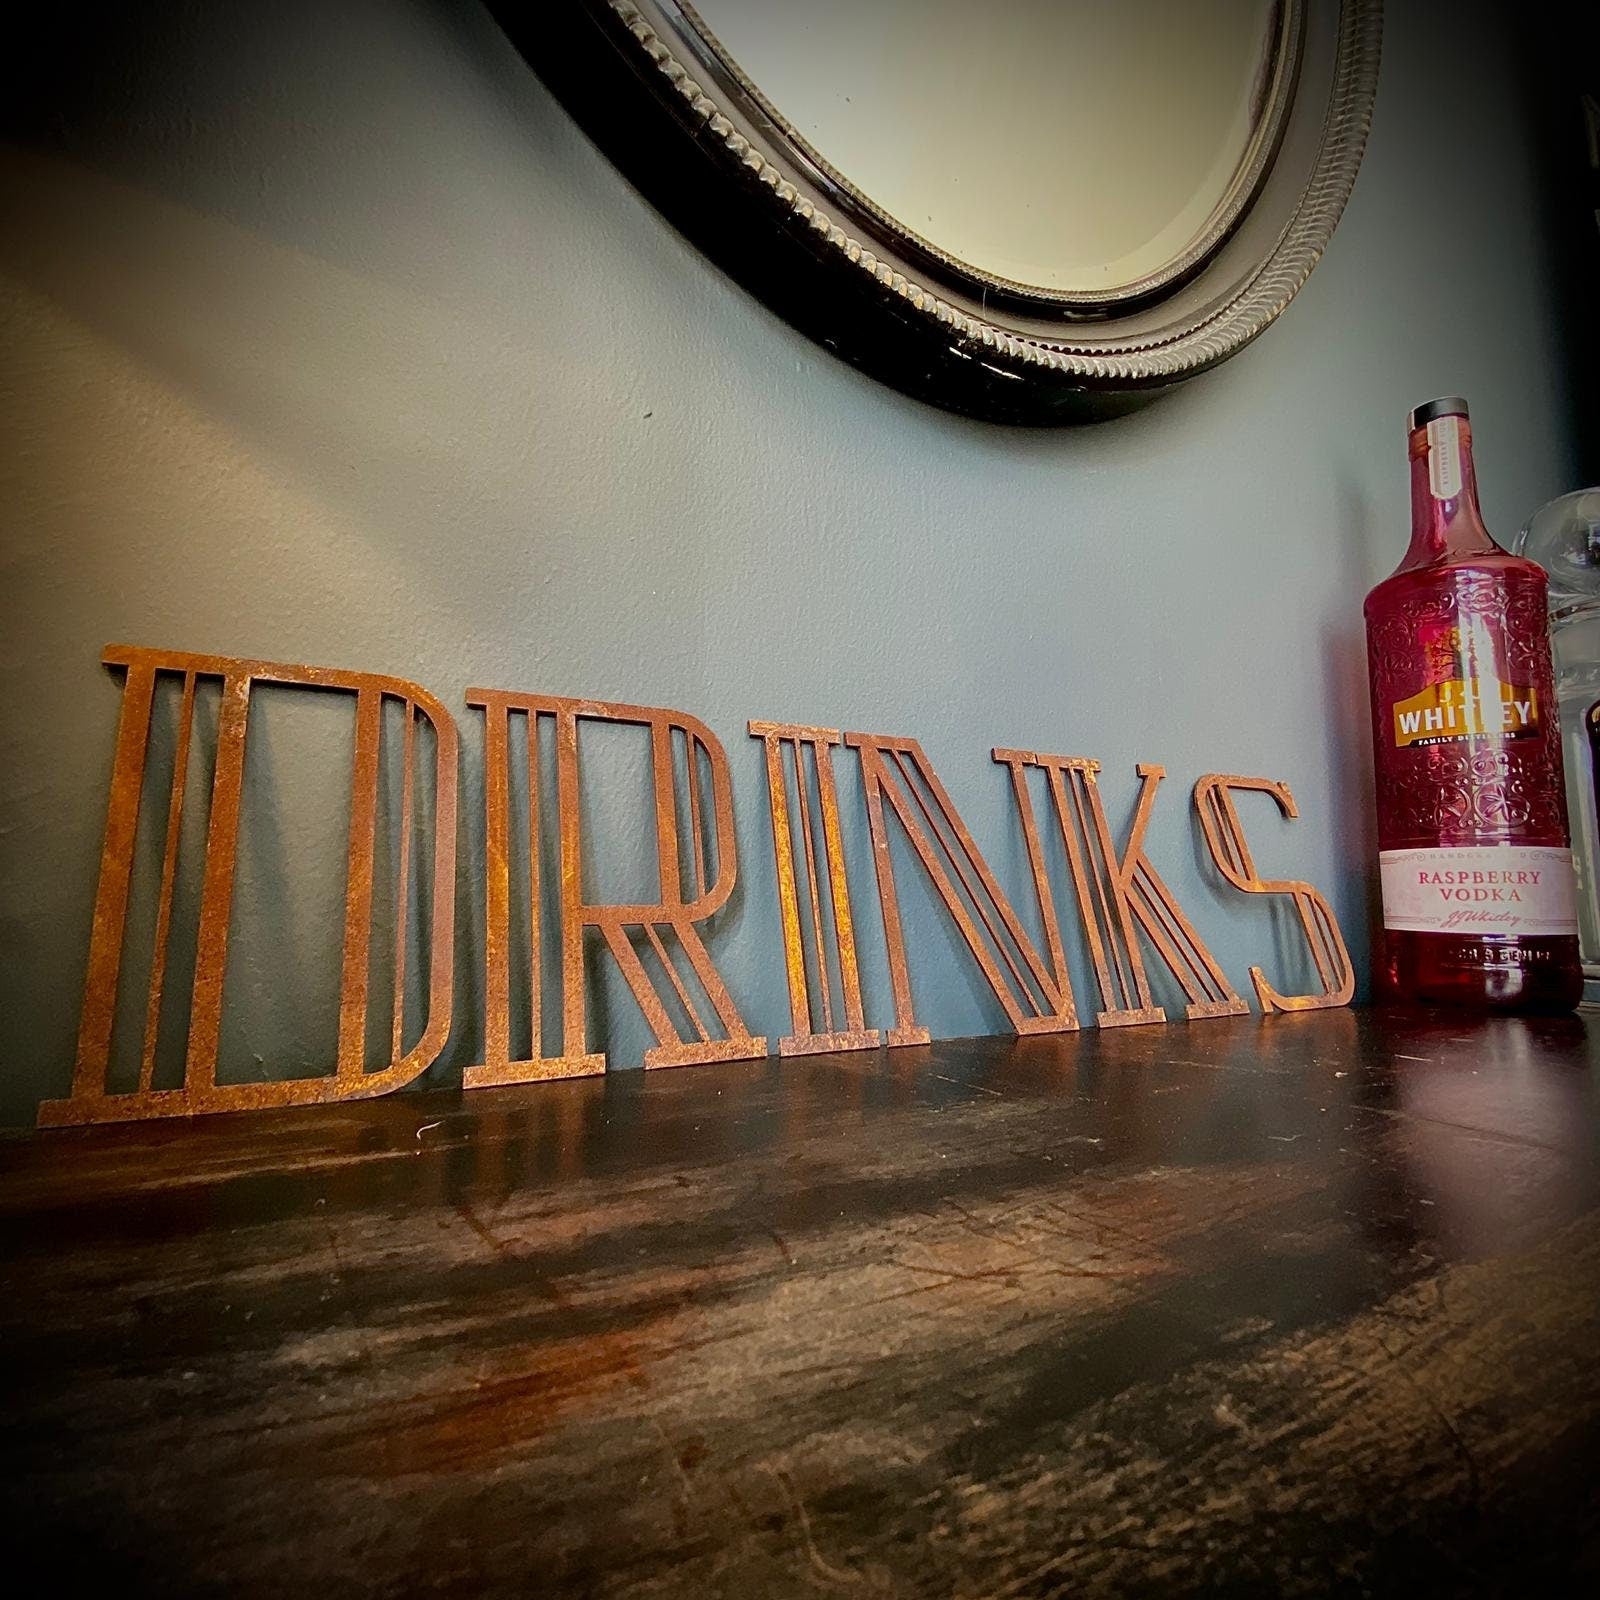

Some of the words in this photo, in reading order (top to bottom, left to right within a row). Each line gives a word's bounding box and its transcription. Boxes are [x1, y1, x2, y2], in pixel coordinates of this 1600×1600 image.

[1398, 701, 1530, 735] WHITEY
[1418, 736, 1453, 746] FAMILY
[1418, 871, 1542, 885] RASPBERRY
[37, 644, 1355, 1128] DRINKS
[1440, 888, 1522, 902] VODKA
